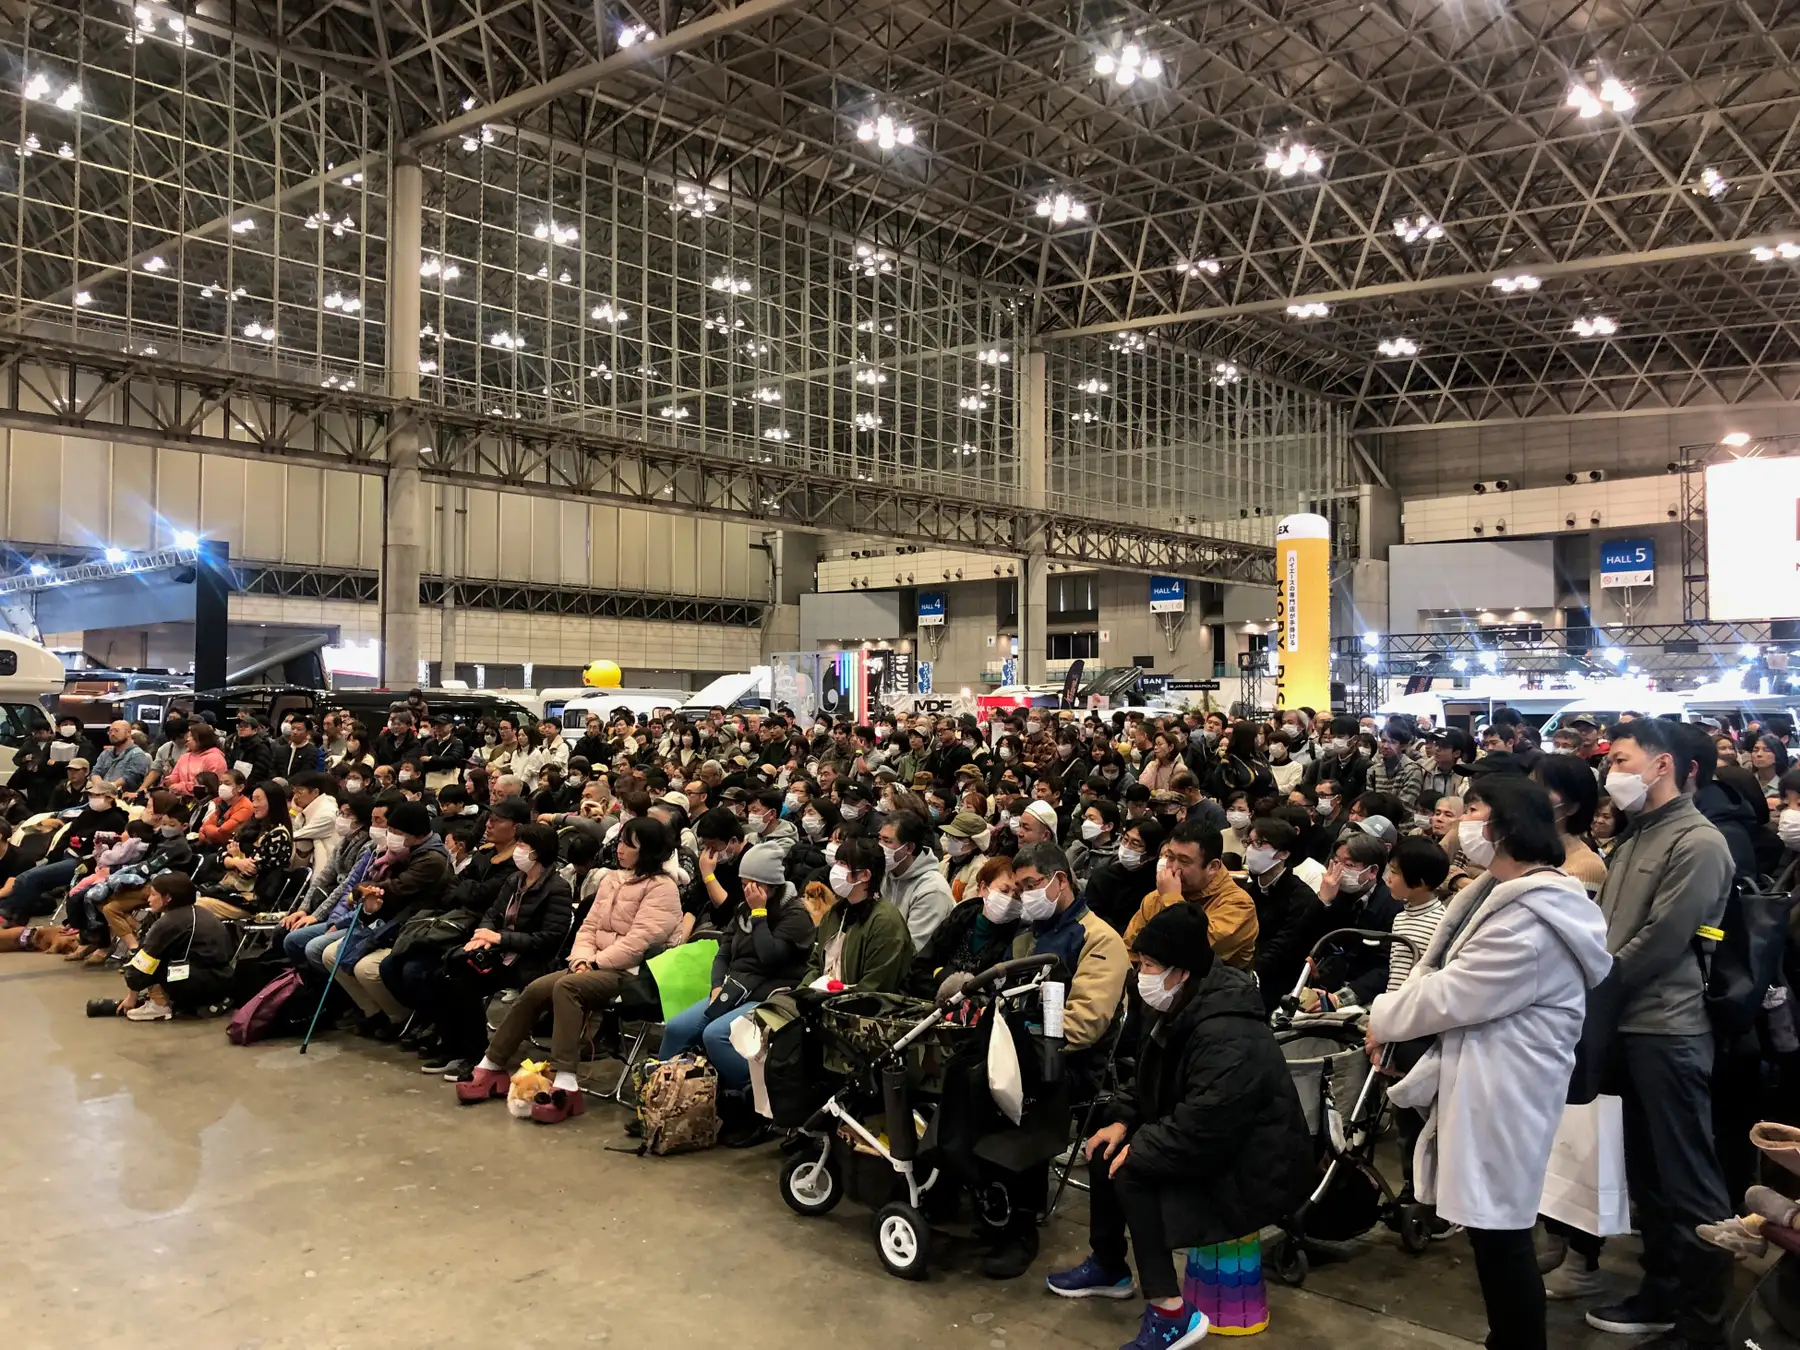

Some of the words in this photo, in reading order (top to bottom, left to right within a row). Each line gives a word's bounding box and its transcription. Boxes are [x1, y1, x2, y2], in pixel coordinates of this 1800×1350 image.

[1276, 524, 1289, 535] EX
[1606, 555, 1632, 564] HALL
[1635, 547, 1646, 562] 5
[1171, 581, 1180, 593] 4
[934, 598, 941, 609] 4
[914, 700, 952, 712] MDF
